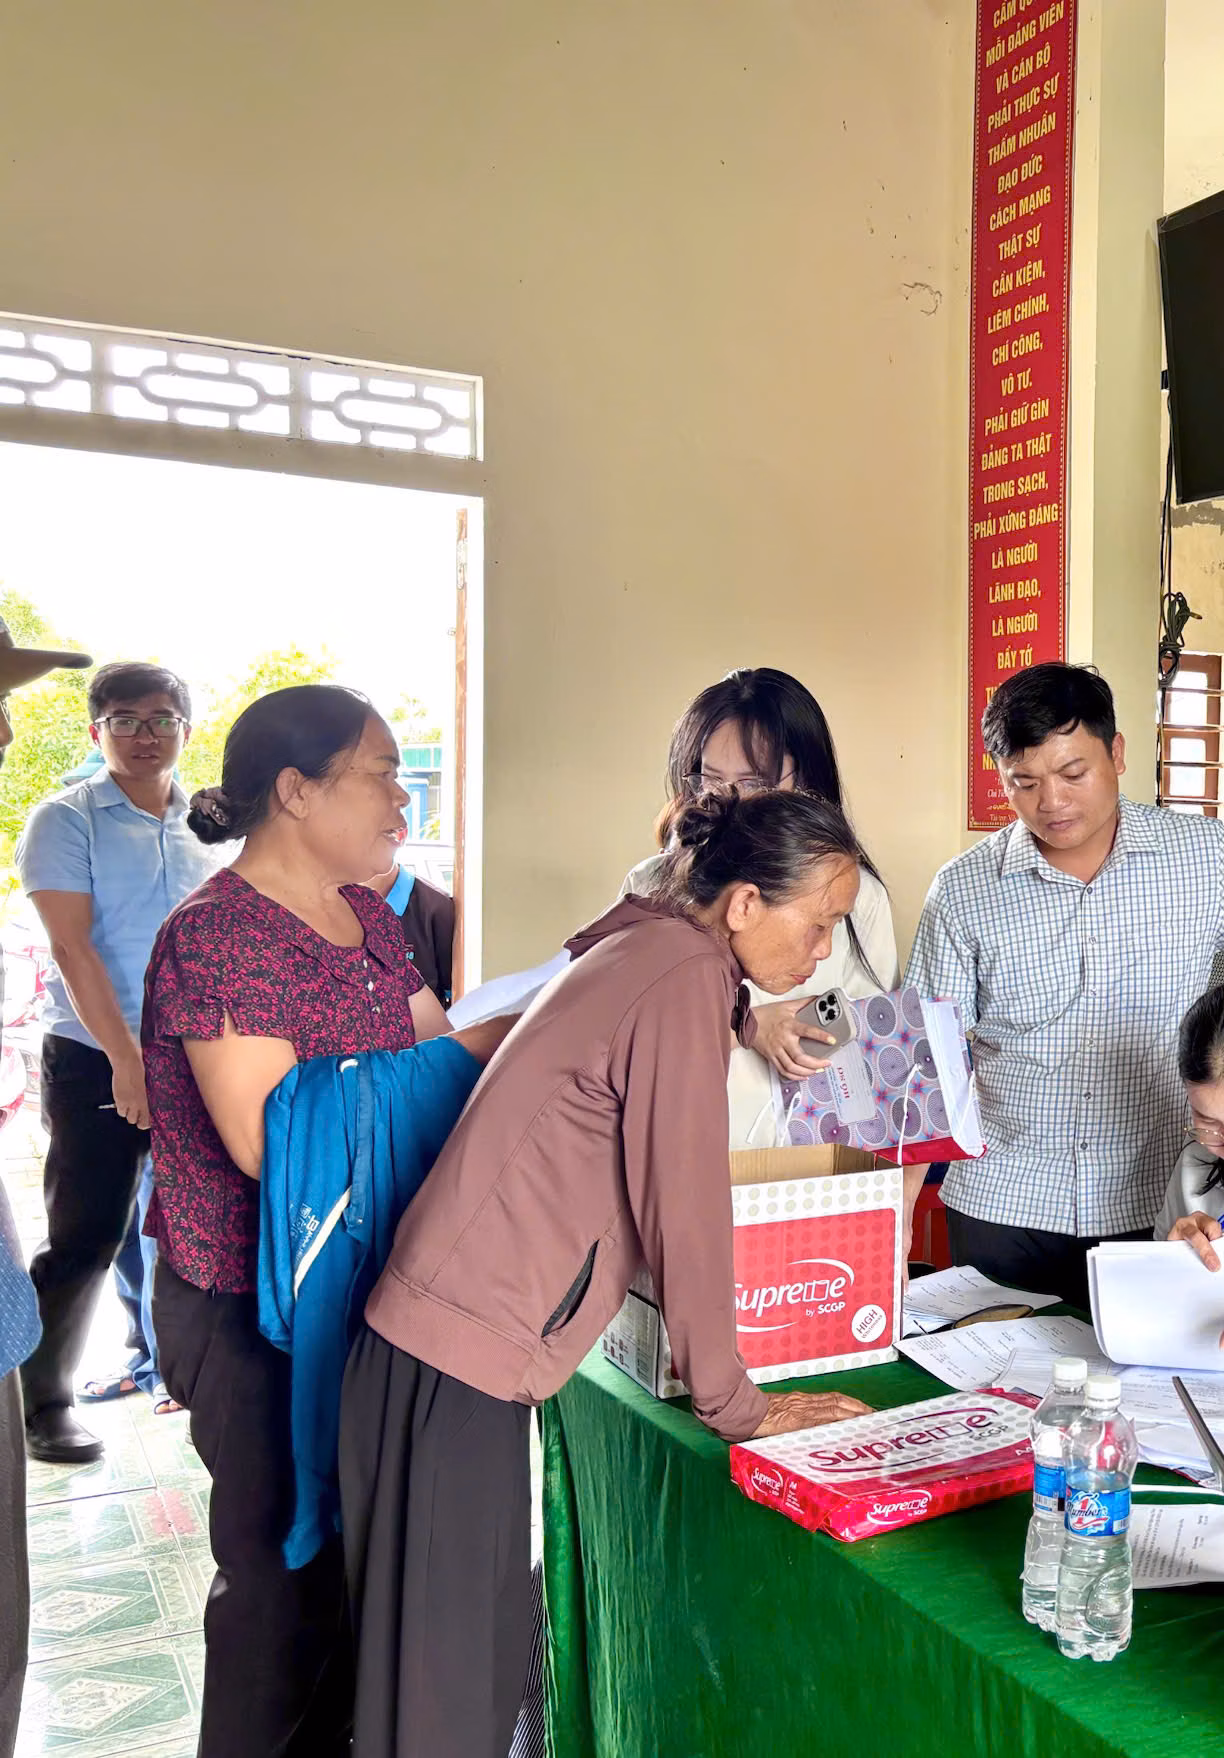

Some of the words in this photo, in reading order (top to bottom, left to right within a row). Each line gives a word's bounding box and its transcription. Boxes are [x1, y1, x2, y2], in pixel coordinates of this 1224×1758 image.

[986, 36, 1005, 67] MỖI
[1007, 22, 1036, 53] ĐẢNG
[1039, 1, 1064, 32] VIÊN
[996, 69, 1009, 94] VÀ
[1011, 56, 1033, 84] CÁN
[1036, 42, 1051, 70] BỘ
[987, 99, 1011, 133] PHẢI
[1014, 87, 1040, 117] THỰC
[1043, 72, 1060, 99] SỰ
[987, 133, 1016, 166] THẤM
[997, 167, 1018, 194] ĐẠO
[1021, 153, 1042, 181] ĐỨC
[989, 206, 1016, 231] CÁCH
[1019, 185, 1051, 216] MẠNG
[998, 233, 1023, 261] THẬT
[1026, 223, 1042, 248] SỰ
[992, 269, 1013, 297] CẦN
[1015, 259, 1045, 287] KIỆM,
[987, 309, 1011, 334] LIÊM
[1014, 293, 1049, 322] CHÍNH,
[992, 341, 1009, 366] CHÍ
[1011, 331, 1043, 358] CÔNG,
[1001, 372, 1014, 396] VÔ
[1017, 368, 1032, 390] TƯ.
[985, 407, 1008, 436] PHẢI
[1010, 400, 1030, 425] GIỮ
[1030, 398, 1049, 421] GÌN
[981, 443, 1008, 471] ĐẢNG
[1011, 443, 1023, 462] TA
[1026, 432, 1052, 460] THẬT
[983, 480, 1014, 505] TRONG
[1017, 471, 1048, 499] SẠCH,
[974, 513, 996, 540] PHẢI
[998, 507, 1026, 534] XỨNG
[1029, 503, 1058, 526] ĐÁNG
[991, 547, 1004, 569] LÀ
[1006, 541, 1038, 566] NGƯỜI
[989, 580, 1014, 604] LÃNH
[1017, 578, 1041, 602] ĐẠO,
[991, 615, 1004, 637] LÀ
[1006, 609, 1038, 633] NGƯỜI
[1020, 645, 1033, 667] TỚ
[806, 1308, 815, 1317] by
[818, 1302, 846, 1314] SCGP
[856, 1309, 878, 1334] HIGH
[808, 1414, 992, 1466] Supreme
[870, 1498, 929, 1517] Supreme
